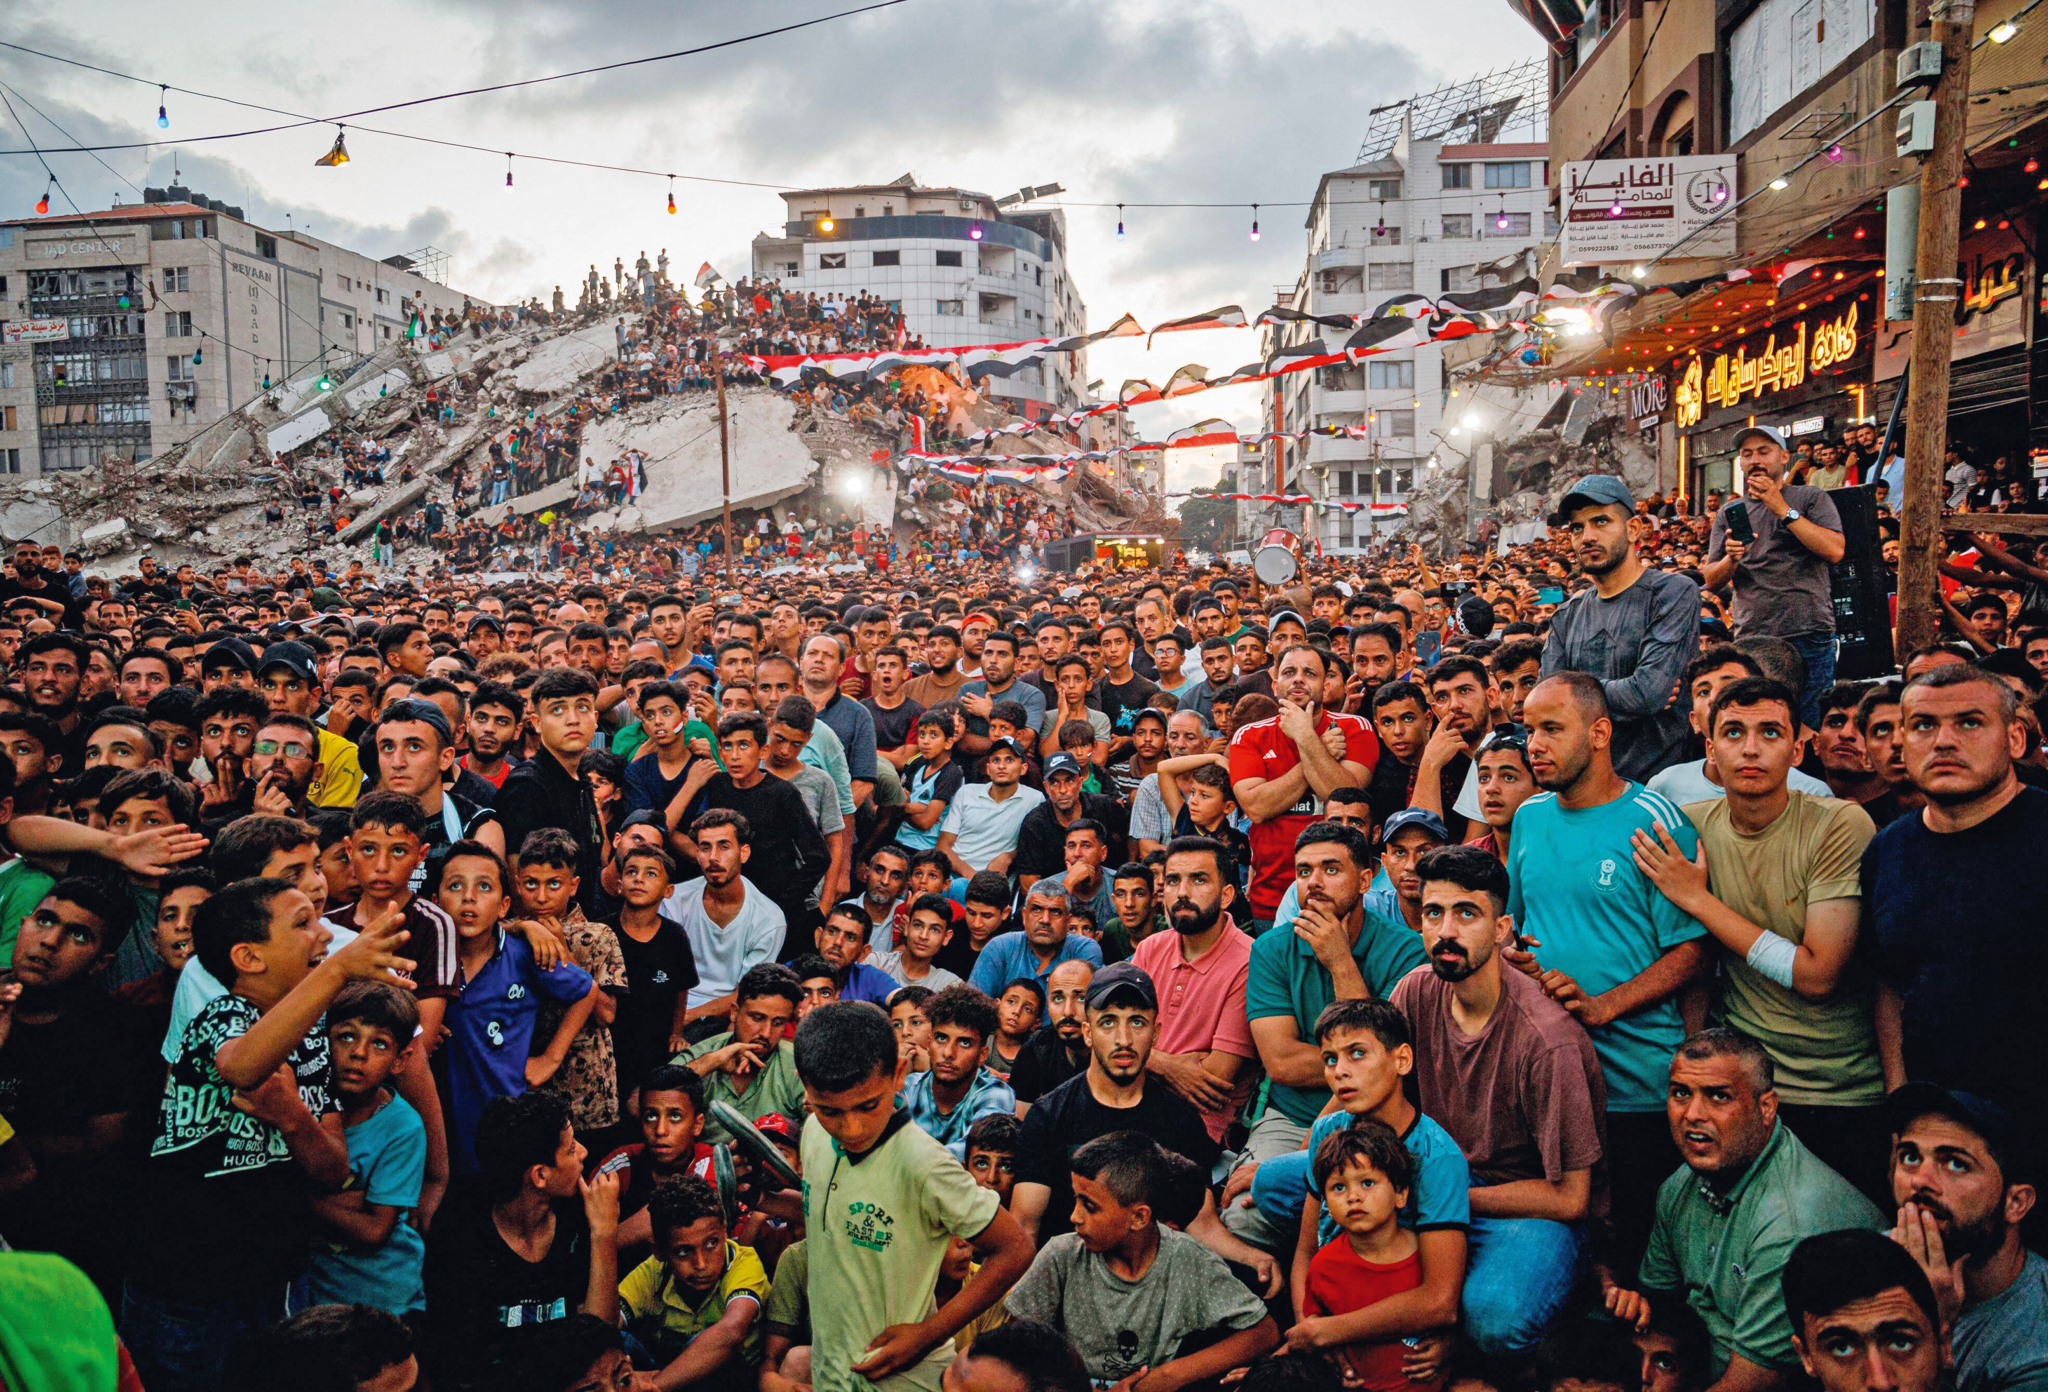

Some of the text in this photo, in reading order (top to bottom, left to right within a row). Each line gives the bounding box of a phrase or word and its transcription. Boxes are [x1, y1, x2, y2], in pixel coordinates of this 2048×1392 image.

[1569, 163, 1674, 196] الفايز
[1575, 188, 1673, 203] للمحاماة
[44, 244, 67, 255] JAD
[1578, 244, 1619, 253] 0599222582
[232, 262, 272, 283] REVAAN
[1631, 375, 1668, 420] MORE
[165, 1110, 174, 1148] HUGO
[222, 1153, 267, 1168] HUGO
[848, 1201, 894, 1227] SPORT
[863, 1214, 875, 1228] &
[846, 1220, 893, 1241] FASTER
